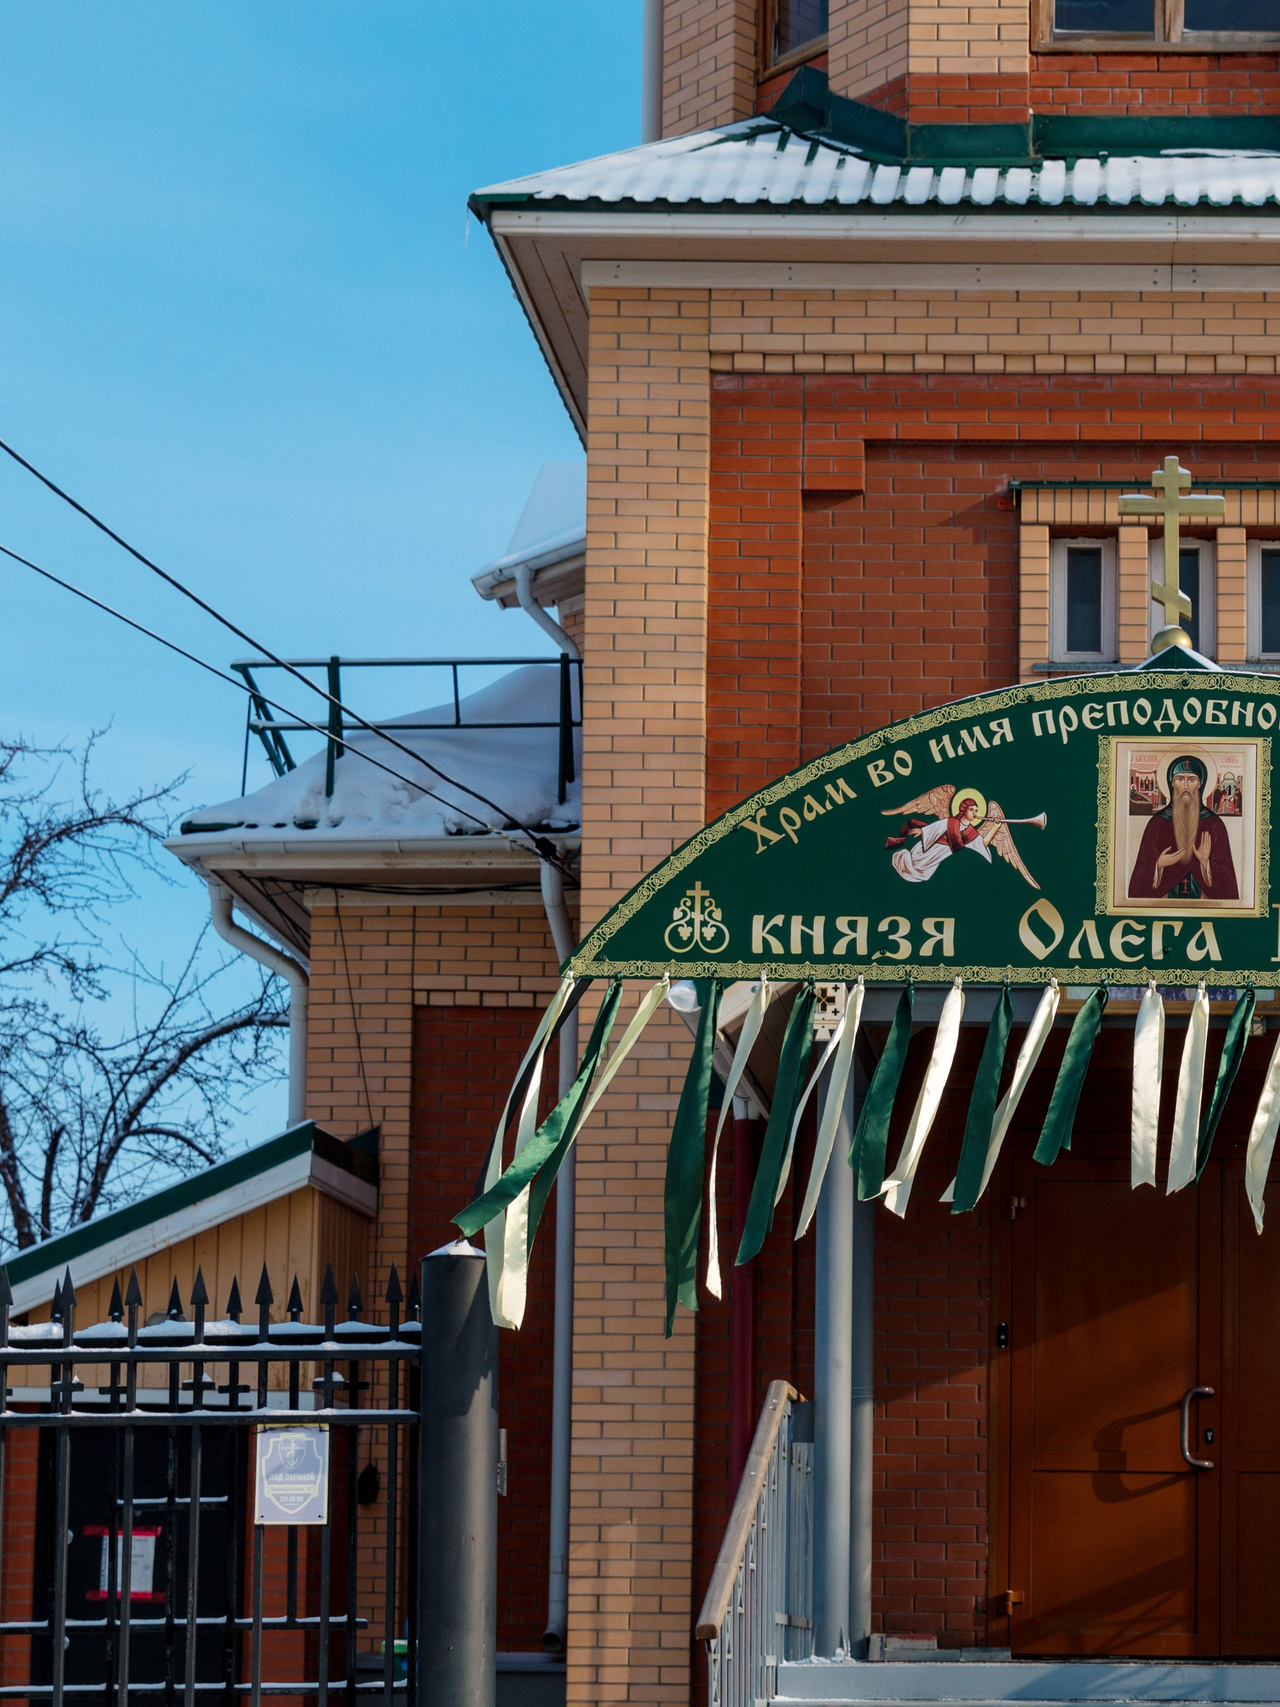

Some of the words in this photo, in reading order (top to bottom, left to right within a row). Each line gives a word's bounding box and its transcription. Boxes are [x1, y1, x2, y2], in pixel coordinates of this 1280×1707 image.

[739, 778, 858, 854] Храм
[866, 749, 914, 788] во
[928, 717, 1014, 765] имя
[752, 913, 956, 961] князя
[1018, 897, 1222, 961] Олега
